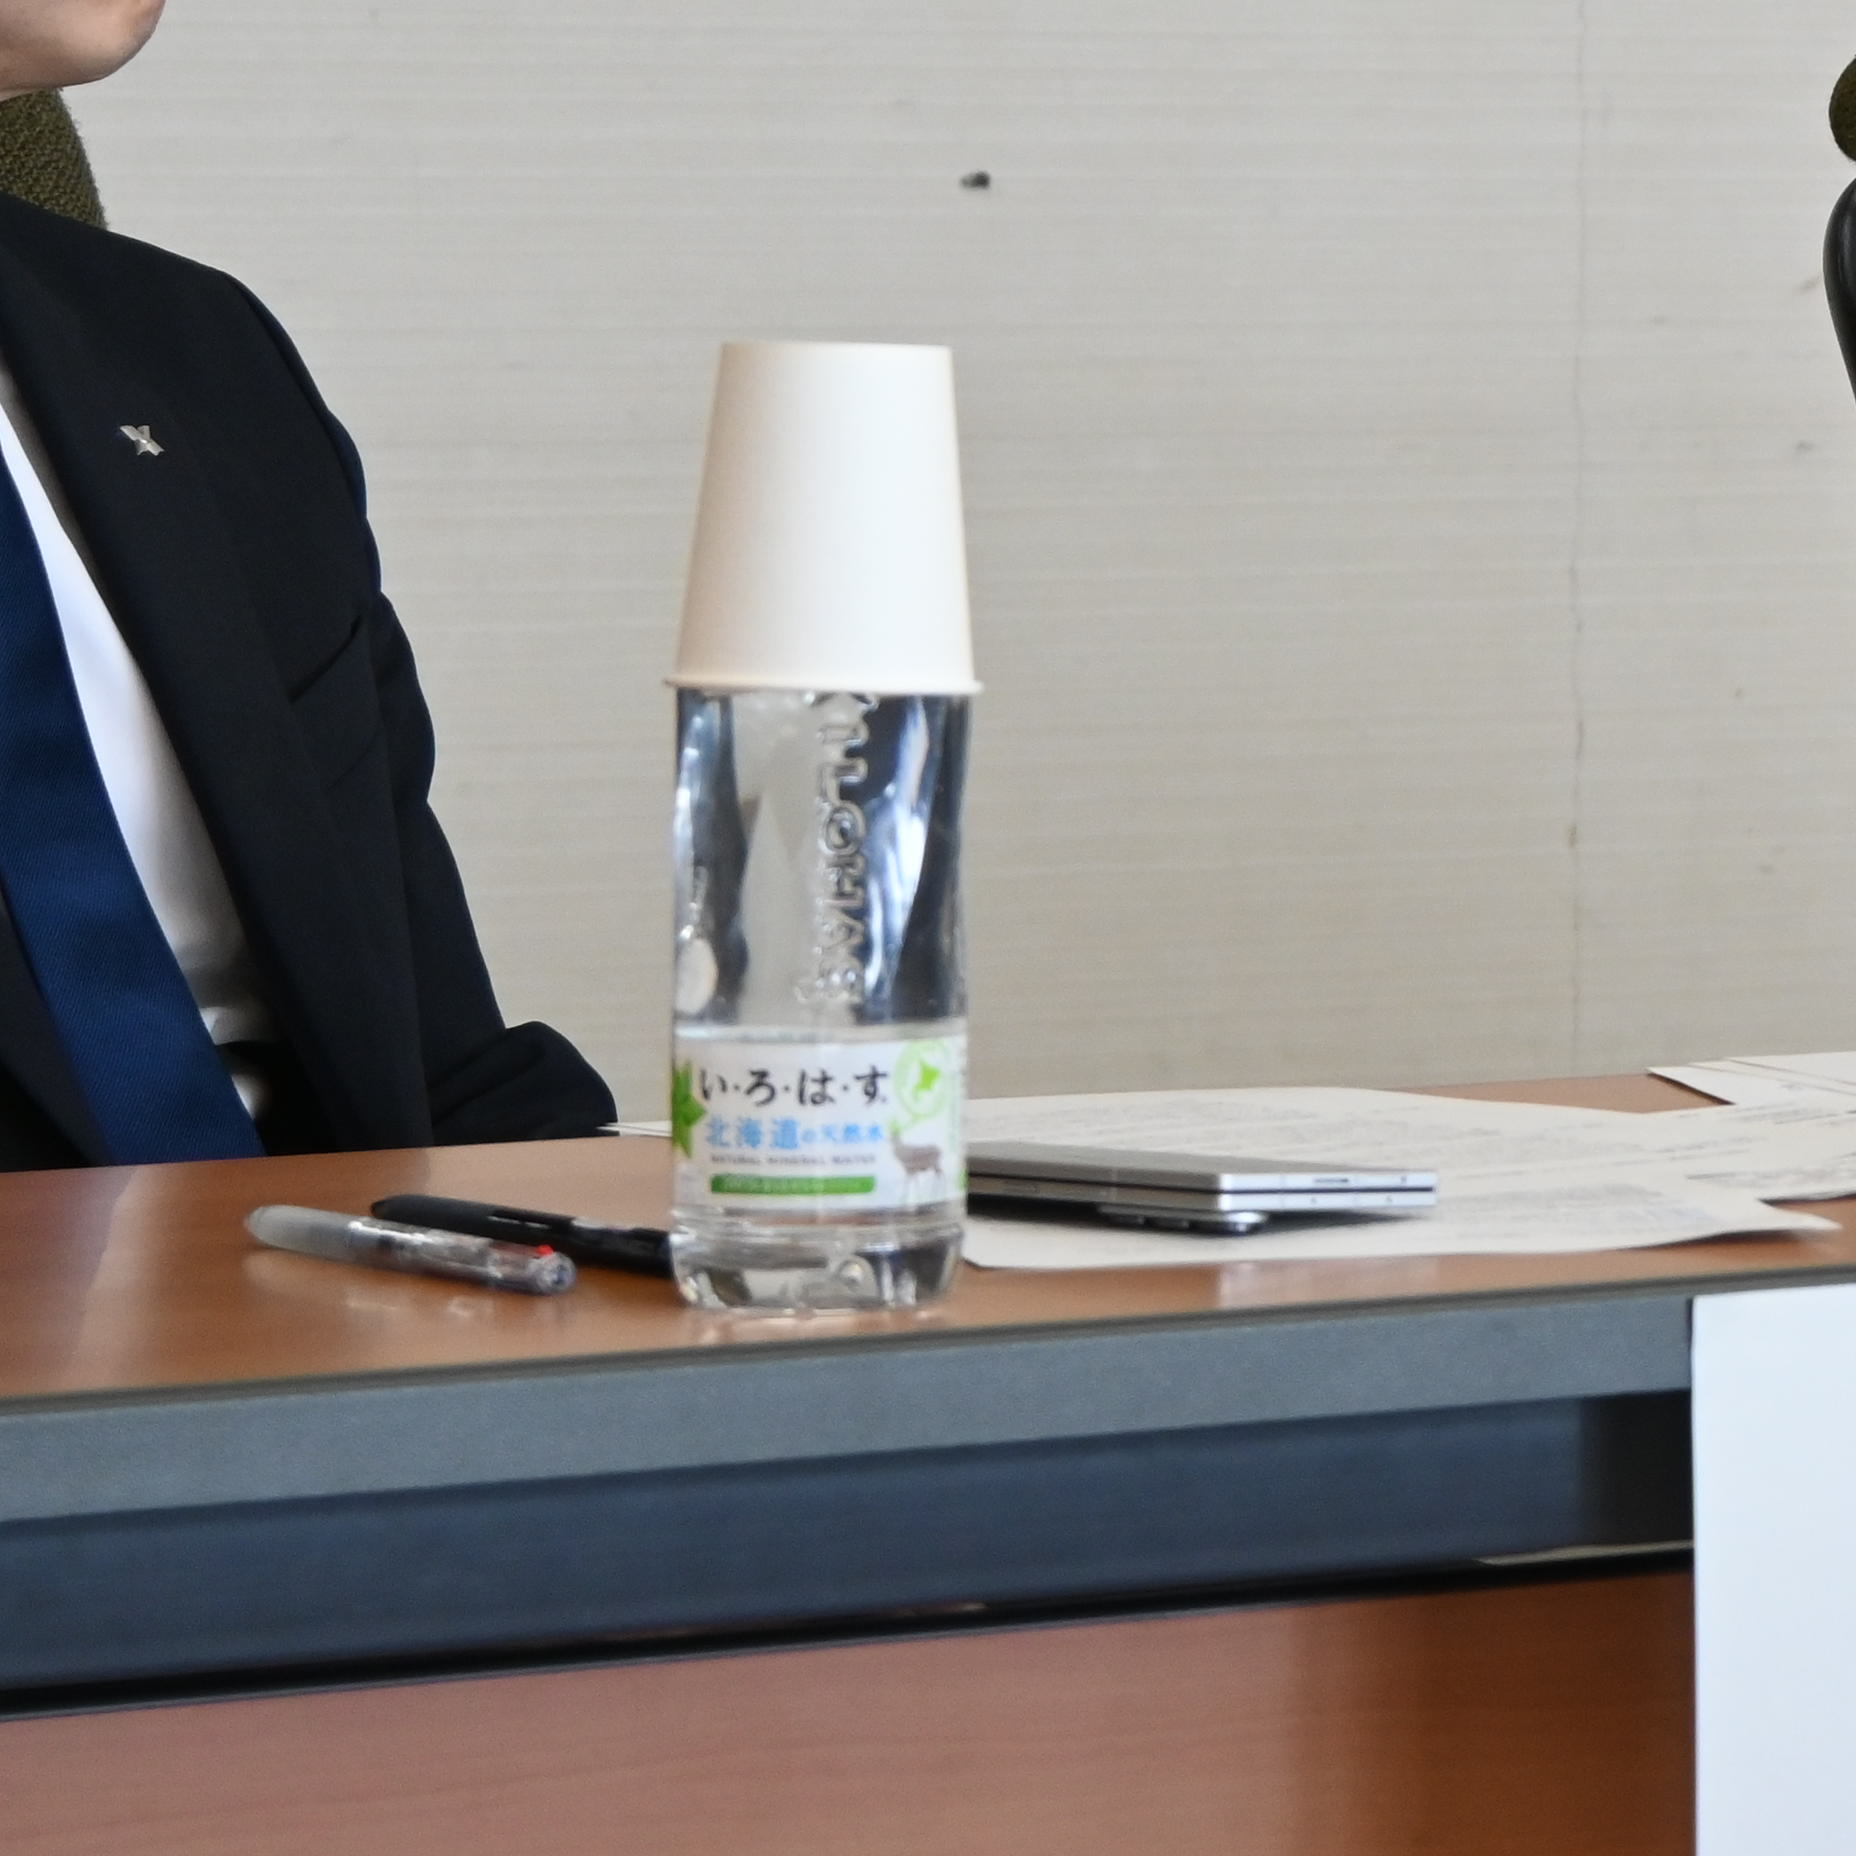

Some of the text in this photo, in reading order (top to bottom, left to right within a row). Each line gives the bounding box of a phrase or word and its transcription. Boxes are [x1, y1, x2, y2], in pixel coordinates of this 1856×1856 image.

[706, 1117, 884, 1150] 北海道の天然水
